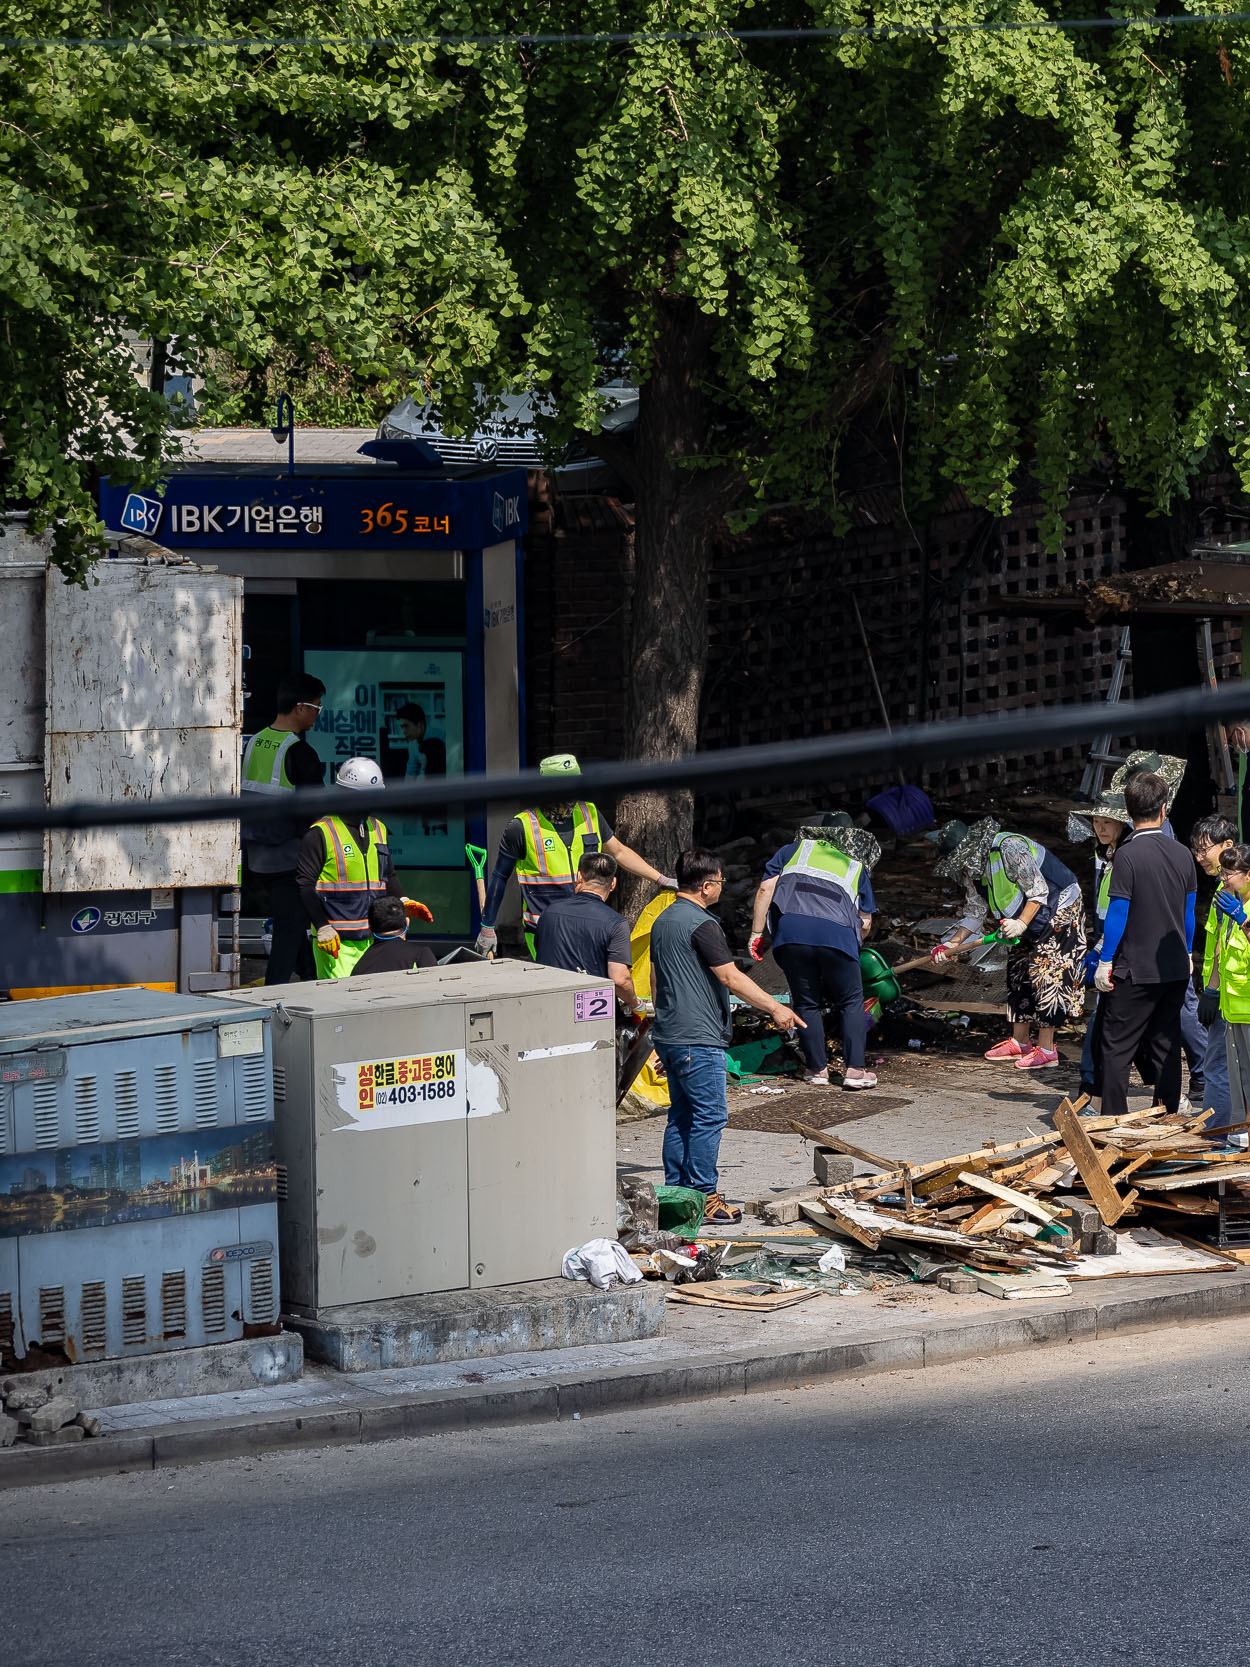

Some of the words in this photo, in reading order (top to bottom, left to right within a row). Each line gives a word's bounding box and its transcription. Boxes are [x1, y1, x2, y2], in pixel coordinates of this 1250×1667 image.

[171, 504, 323, 534] IBK기업은행
[505, 495, 520, 526] IBK
[413, 515, 449, 534] 코너
[354, 684, 376, 708] 이
[104, 910, 157, 926] 광진구
[576, 993, 584, 1019] 터미널
[589, 998, 608, 1016] 2
[358, 1064, 374, 1110] 성인
[388, 1080, 456, 1105] 403-1588
[226, 1247, 255, 1259] KEPCO
